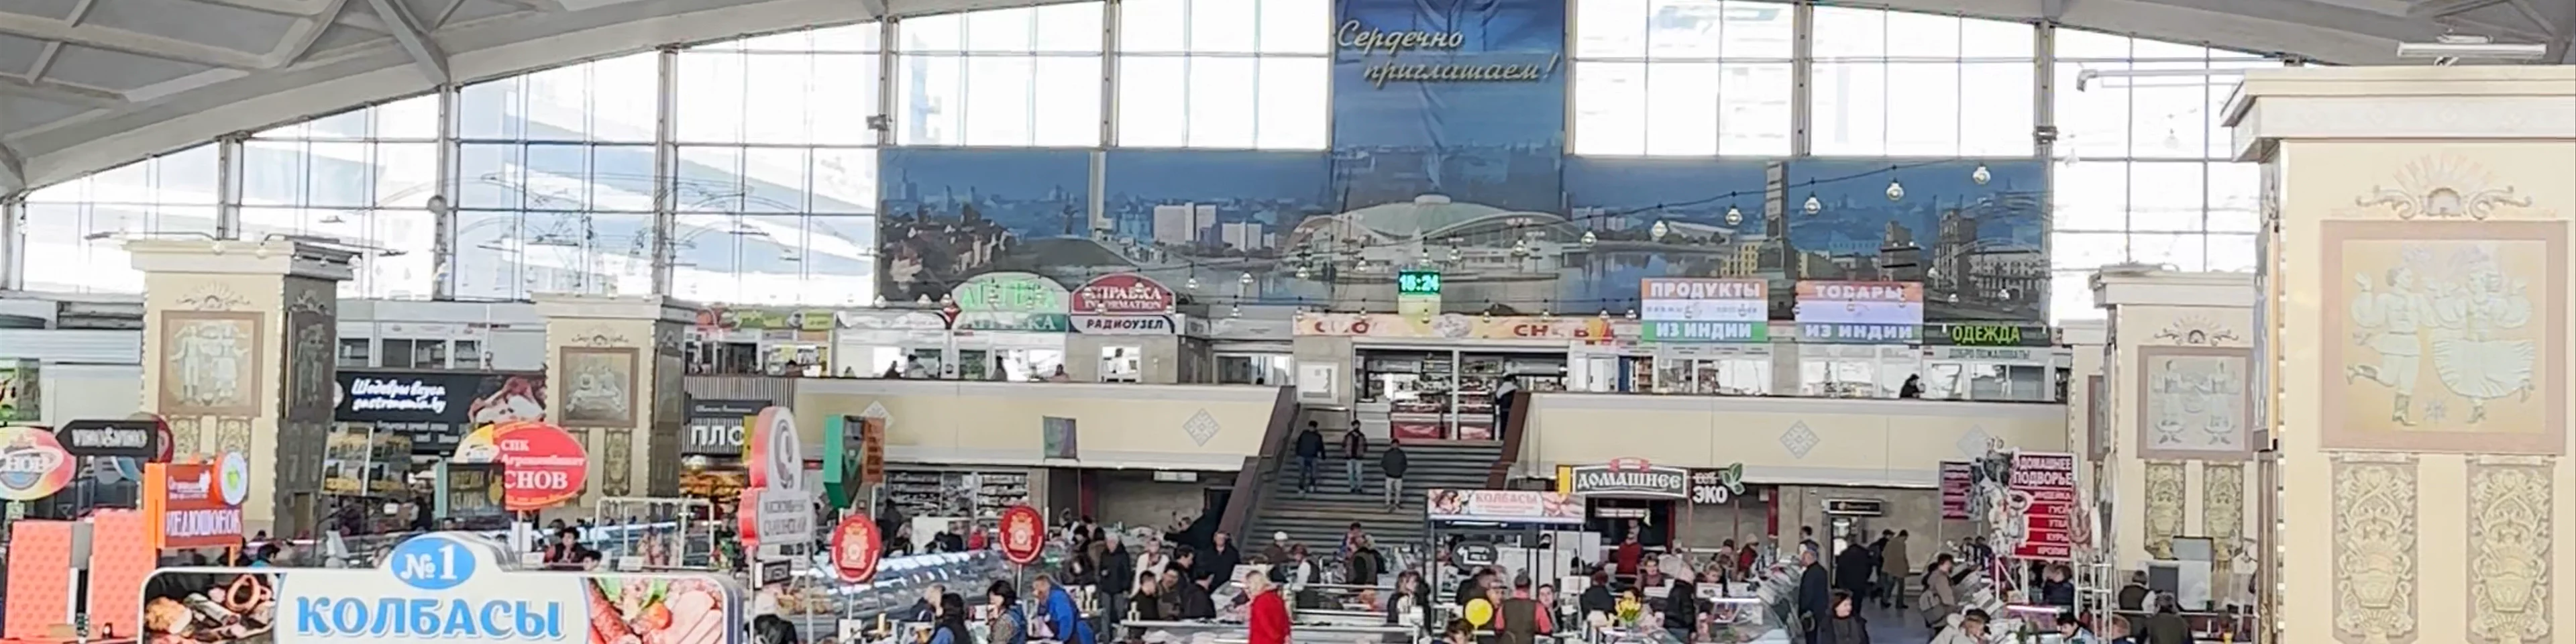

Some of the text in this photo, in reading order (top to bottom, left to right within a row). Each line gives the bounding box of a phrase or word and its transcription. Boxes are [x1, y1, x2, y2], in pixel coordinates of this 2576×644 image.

[1338, 19, 1464, 56] Сердечно
[1363, 52, 1560, 89] приглашаем!
[1650, 282, 1761, 299] ПРОДУКТЫ
[1815, 284, 1903, 300] ТОВАРЫ
[1085, 300, 1161, 309] INORMATION
[1086, 319, 1164, 329] РАДИОУЗЕЛ
[1656, 322, 1752, 340] ИЗ ИНДИИ
[1805, 324, 1913, 341] ИЗ ИНДИИ
[1952, 325, 2021, 345] ОДЕЖДА
[501, 439, 530, 451] СПК
[504, 470, 568, 489] СНОВ
[1577, 471, 1682, 490] ДОМАШНЕЕ
[2013, 470, 2072, 486] ПОДВОРЬЕ
[1475, 492, 1538, 504] КОЛБАСЫ
[1693, 485, 1728, 503] ЭКО
[296, 596, 567, 639] КОЛБАСЫ
